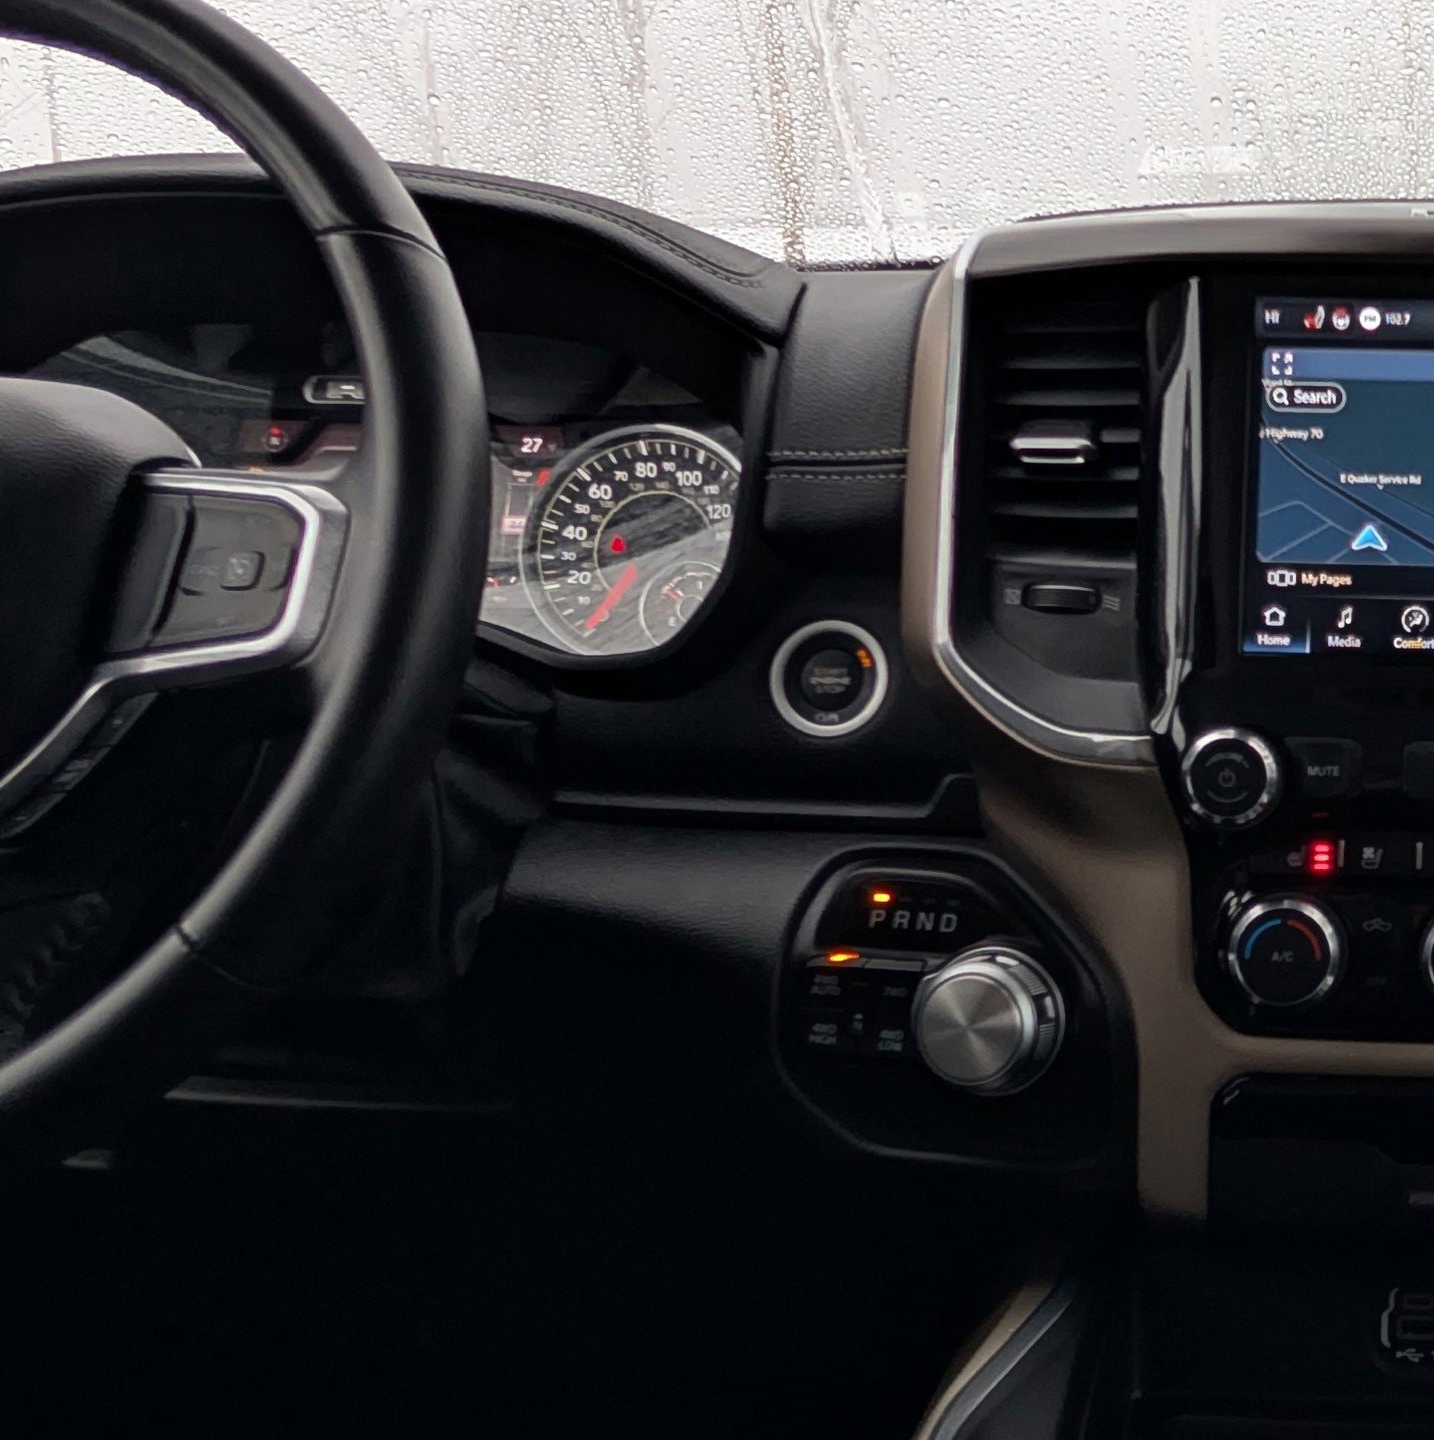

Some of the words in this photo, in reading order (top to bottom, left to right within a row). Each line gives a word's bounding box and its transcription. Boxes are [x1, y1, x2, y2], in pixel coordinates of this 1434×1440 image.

[1264, 309, 1281, 325] HI
[1292, 388, 1338, 406] Search
[520, 437, 544, 454] 27
[634, 462, 658, 478] 80
[674, 470, 703, 487] 100
[587, 483, 613, 500] 60
[572, 503, 591, 515] 50
[705, 503, 732, 520] 120
[561, 525, 588, 541] 40
[560, 551, 577, 562] 30
[565, 570, 592, 586] 20
[1300, 571, 1319, 588] My
[1319, 572, 1353, 588] Pages
[1255, 633, 1292, 647] Home
[1327, 634, 1362, 648] Media
[1306, 765, 1341, 778] MUTE
[868, 909, 887, 929] P
[892, 910, 911, 930] R
[916, 912, 936, 931] N
[939, 913, 958, 933] D
[1270, 950, 1295, 962] A/C
